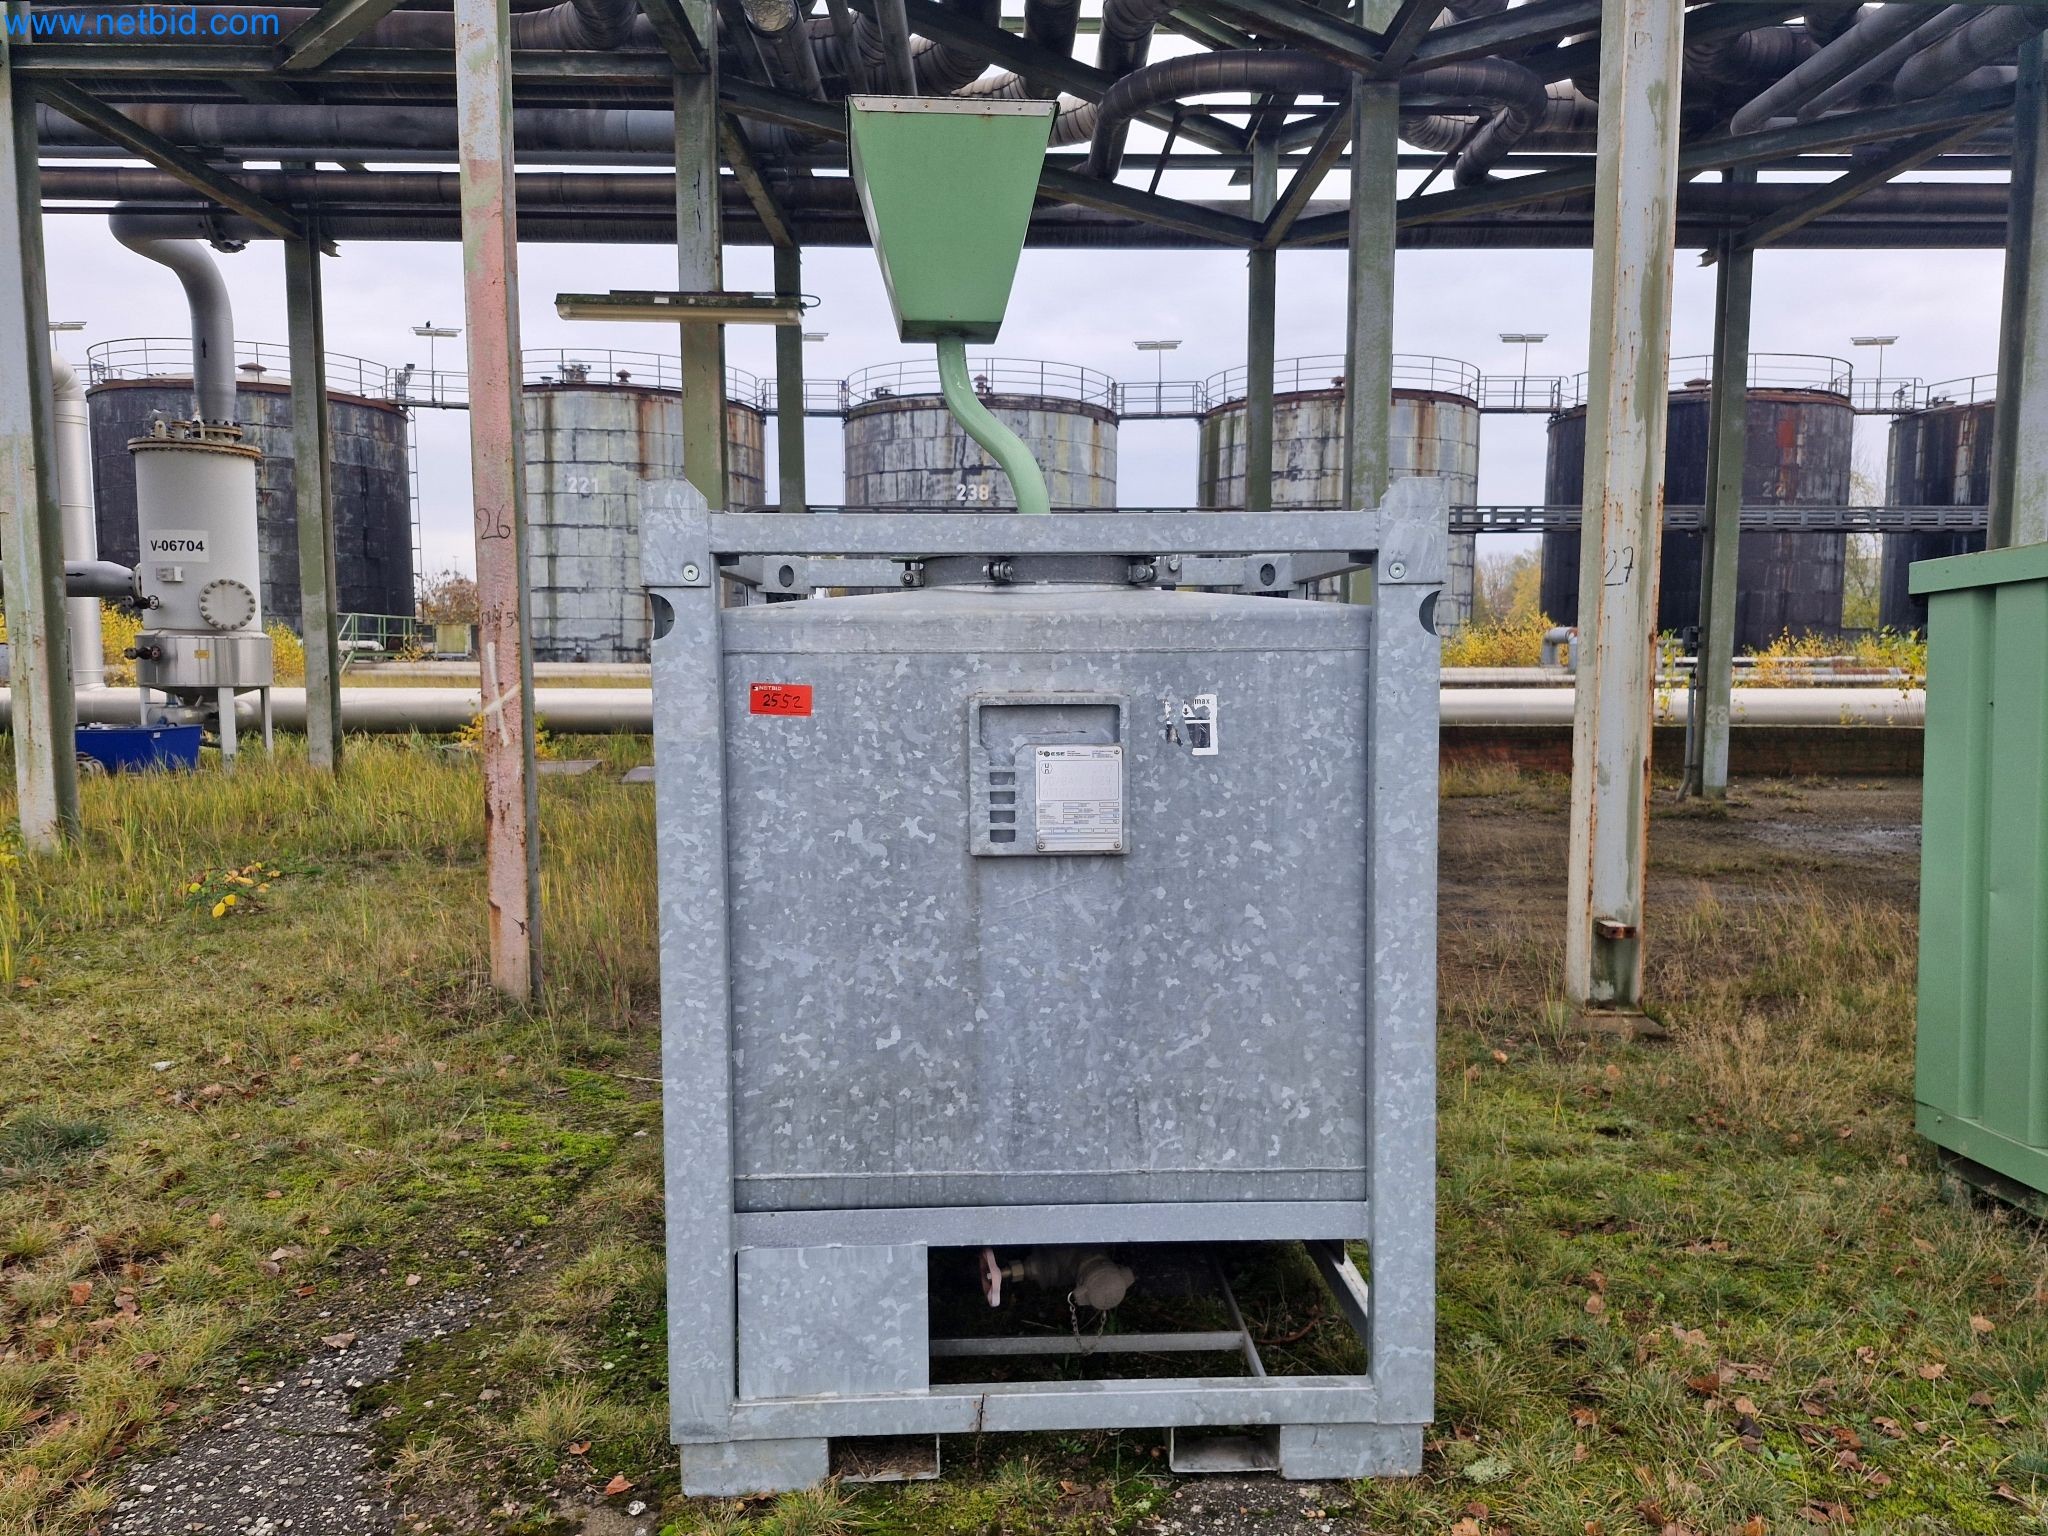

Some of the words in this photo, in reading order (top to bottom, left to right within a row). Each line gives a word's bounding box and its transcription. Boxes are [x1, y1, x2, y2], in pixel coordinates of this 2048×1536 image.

[568, 477, 598, 493] 221
[957, 484, 989, 501] 238
[476, 505, 510, 539] 26
[151, 540, 204, 552] V-06704
[1604, 546, 1633, 586] 27
[763, 693, 803, 708] 2552
